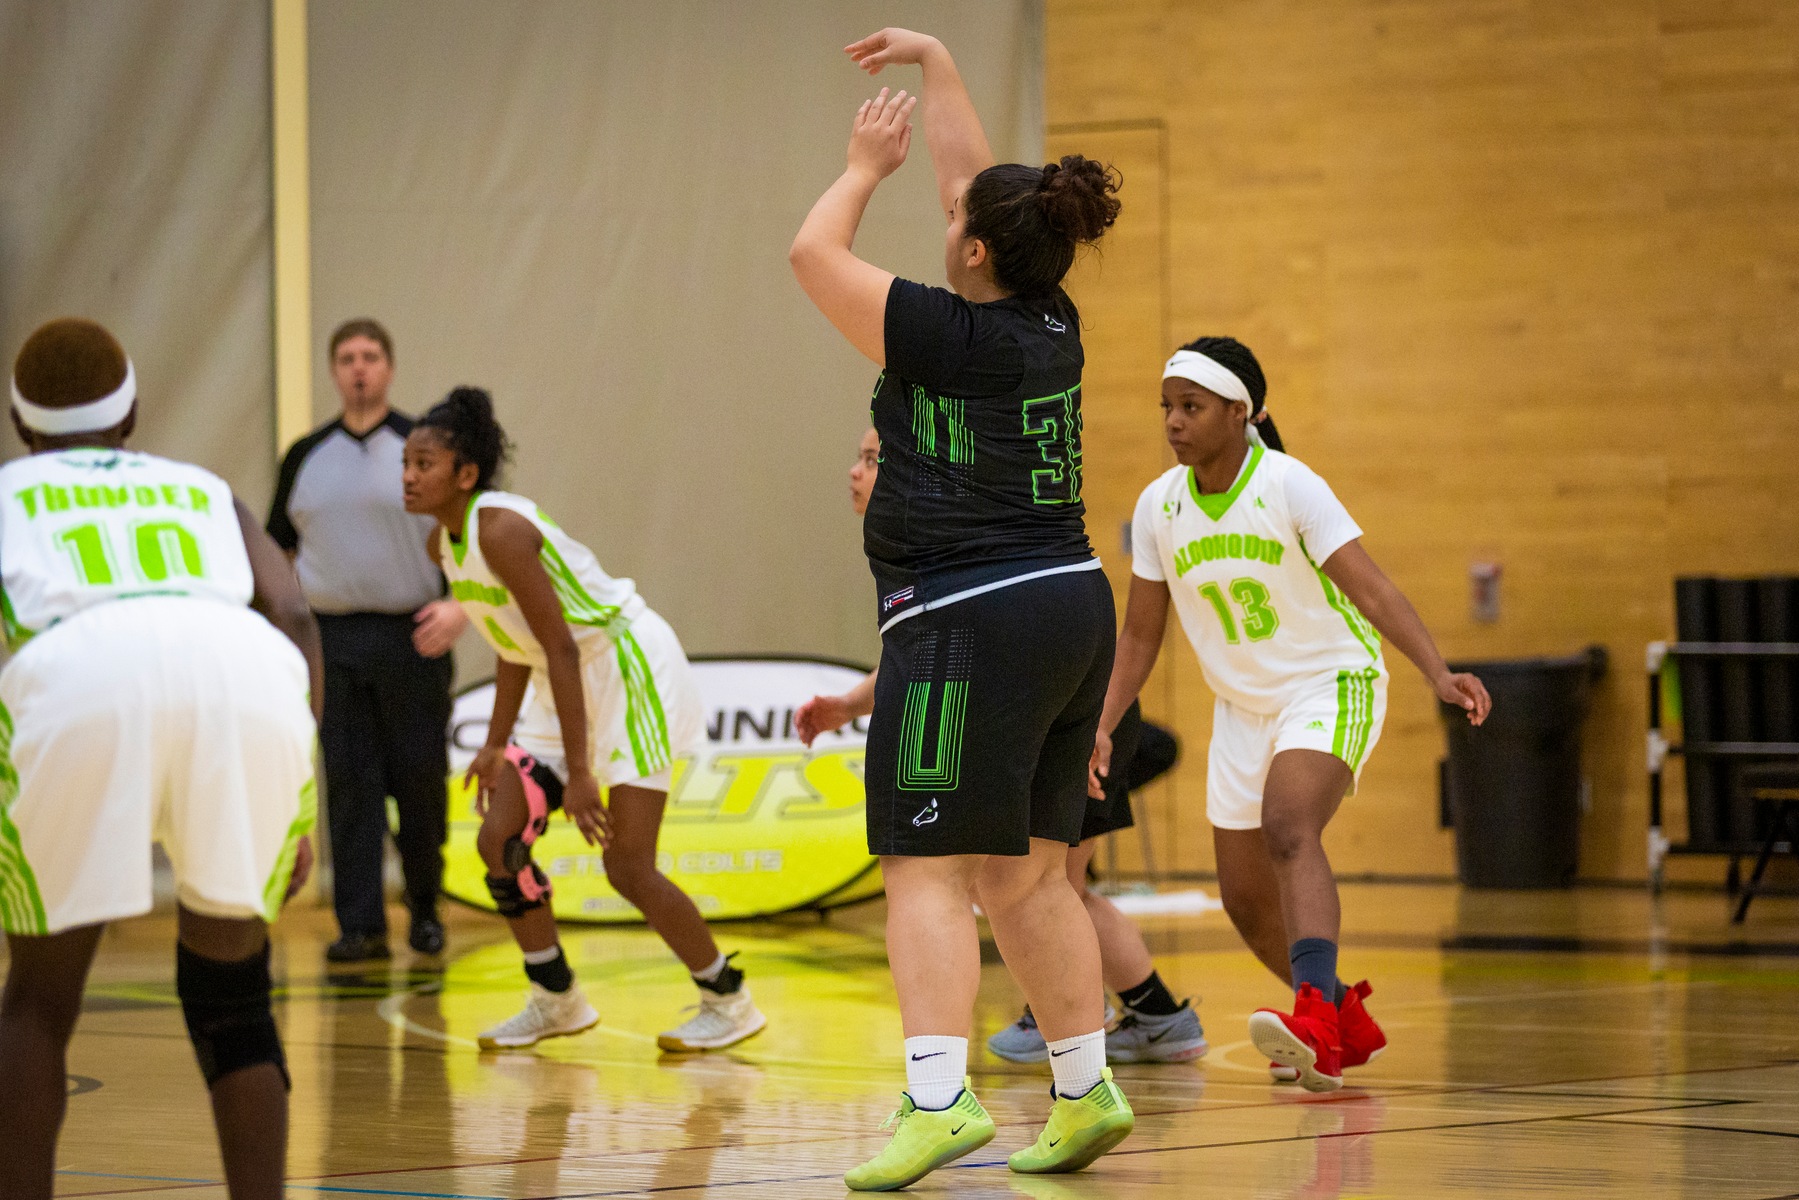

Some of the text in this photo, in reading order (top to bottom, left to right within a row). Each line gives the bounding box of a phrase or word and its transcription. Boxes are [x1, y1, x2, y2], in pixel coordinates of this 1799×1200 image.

[13, 481, 213, 520] THUNDER
[53, 520, 207, 586] 10
[1197, 576, 1280, 645] 13
[677, 848, 783, 875] COLTS
